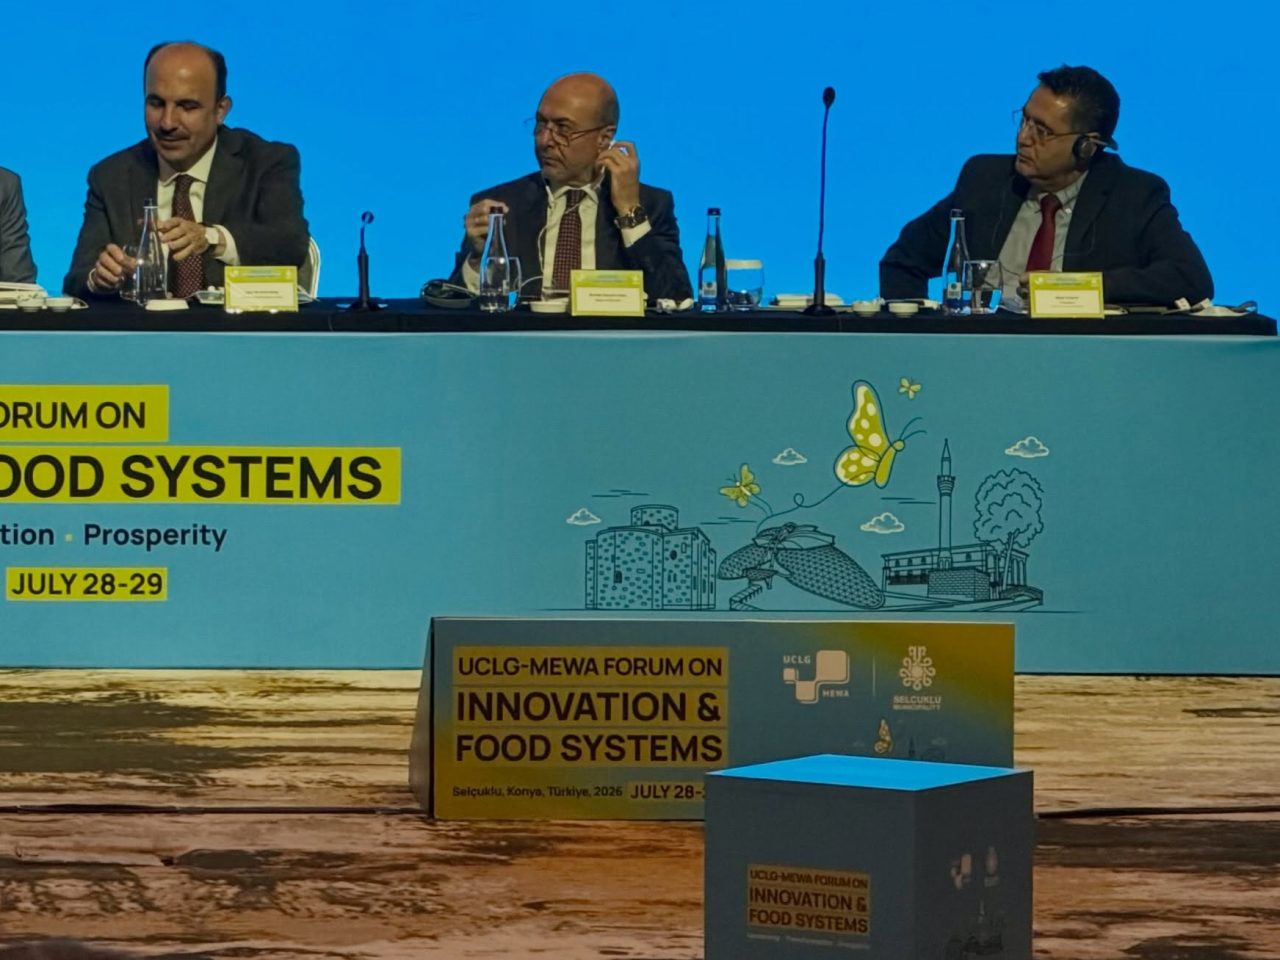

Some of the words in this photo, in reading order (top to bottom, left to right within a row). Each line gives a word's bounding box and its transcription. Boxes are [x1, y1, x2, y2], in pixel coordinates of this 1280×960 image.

[96, 402, 146, 429] ON
[120, 455, 383, 500] SYSTEMS
[84, 524, 228, 552] Prosperity
[11, 573, 77, 596] JULY
[83, 574, 163, 596] 28-29
[458, 657, 599, 676] UCLG-MEWA
[604, 657, 684, 676] FORUM
[689, 658, 722, 677] ON
[783, 655, 811, 664] UCLG
[457, 692, 686, 721] INNOVATION
[697, 692, 721, 721] &
[456, 734, 552, 762] FOOD
[560, 734, 723, 762] SYSTEMS
[593, 786, 623, 797] 2026
[630, 785, 671, 800] JULY
[814, 875, 851, 887] FORUM
[852, 878, 868, 889] ON
[749, 887, 853, 911] INNOVATION
[856, 897, 867, 912] &
[749, 908, 792, 925] FOOD
[795, 913, 869, 933] SYSTEMS
